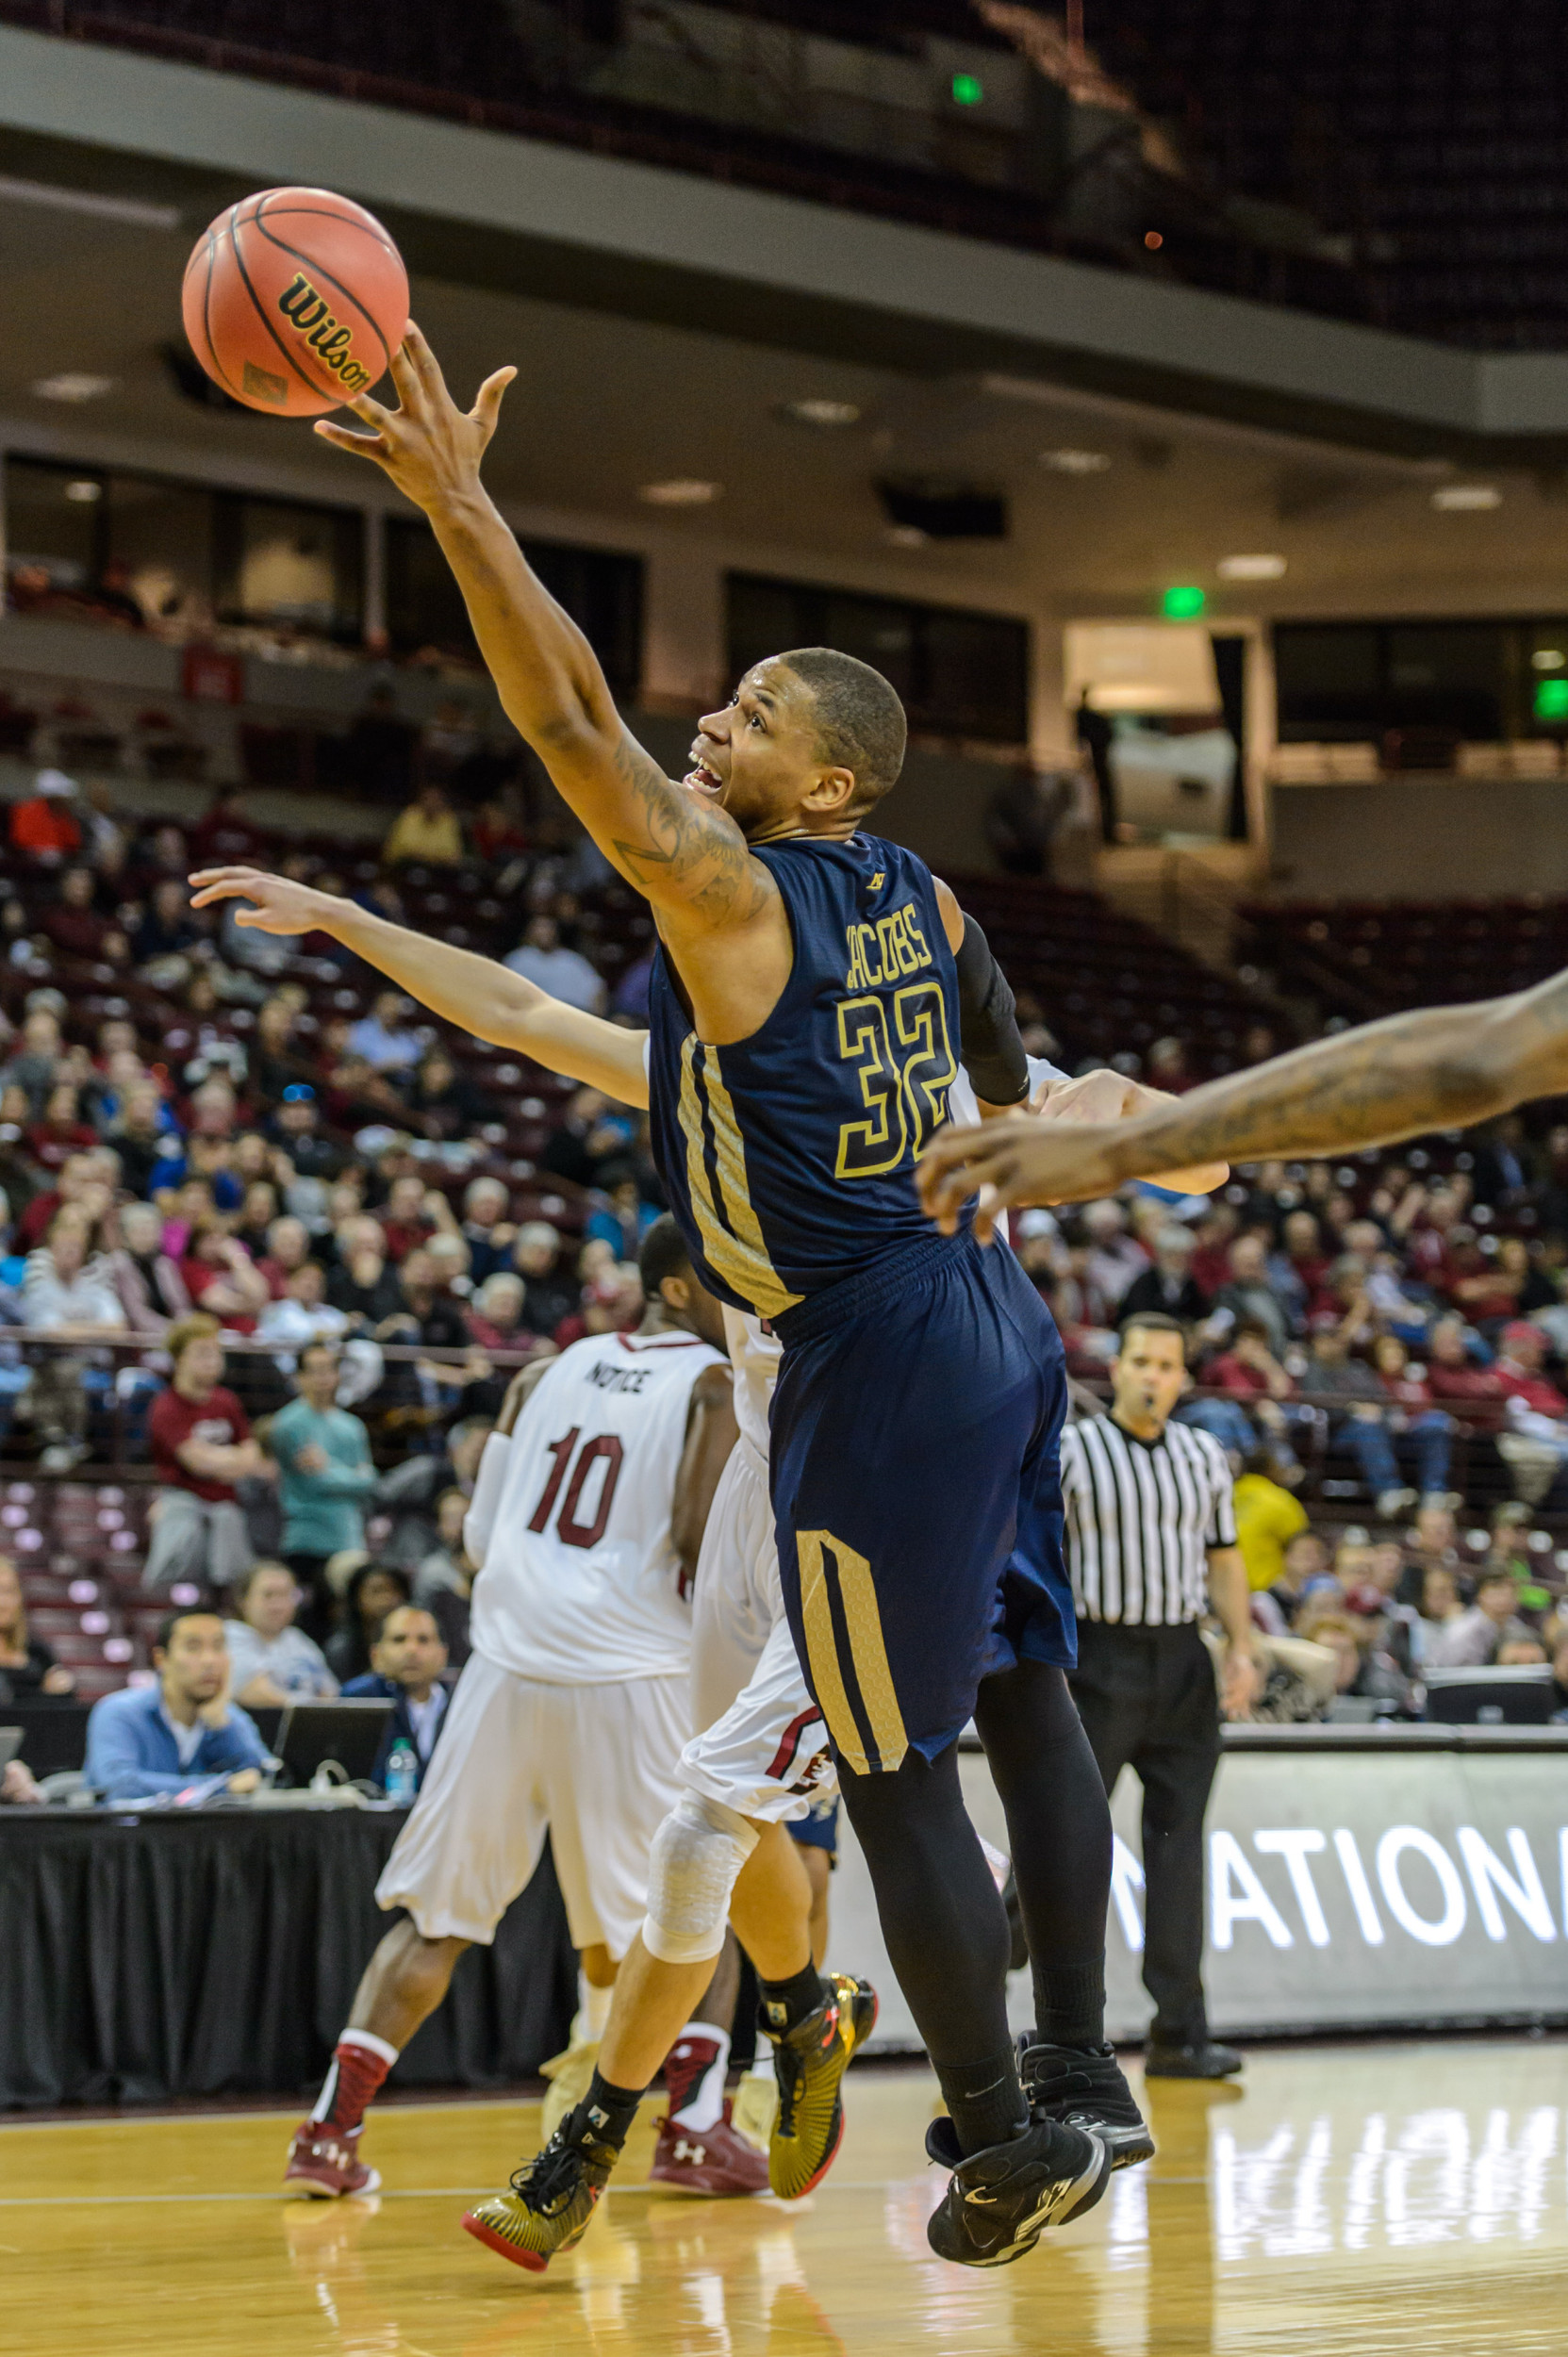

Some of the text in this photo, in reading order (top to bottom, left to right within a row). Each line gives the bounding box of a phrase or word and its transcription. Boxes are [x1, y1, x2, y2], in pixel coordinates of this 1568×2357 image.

[277, 271, 372, 395] Wilson
[834, 981, 958, 1178] 32
[586, 1360, 652, 1394] NOTICE
[527, 1426, 624, 1550] 10
